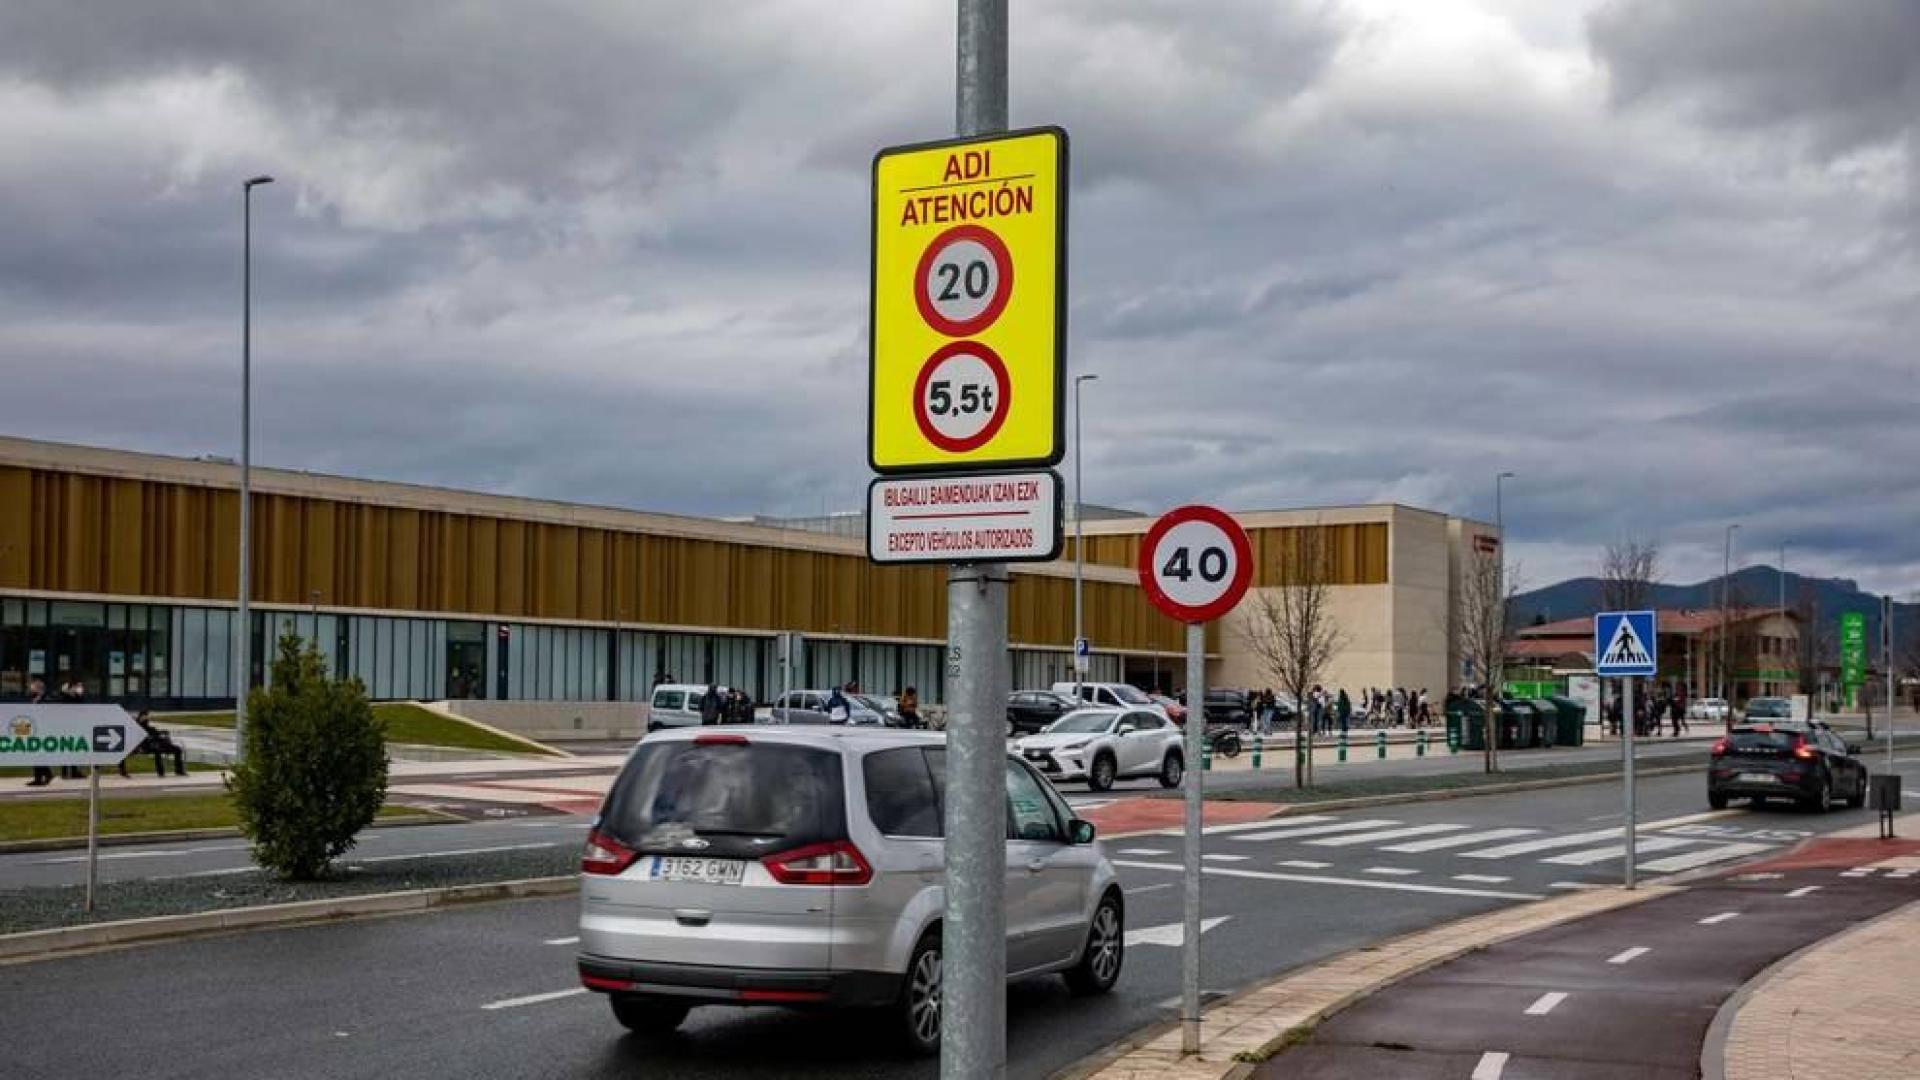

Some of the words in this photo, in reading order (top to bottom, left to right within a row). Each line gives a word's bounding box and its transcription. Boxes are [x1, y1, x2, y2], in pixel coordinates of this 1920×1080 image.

[943, 149, 991, 182] ADI
[900, 181, 1034, 226] ATENCIÓN
[937, 259, 991, 301] 20
[929, 379, 994, 417] 5,5t
[884, 486, 927, 507] IBILGAILU
[930, 484, 992, 505] BAIMENDUAK
[993, 482, 1015, 502] IZAN
[1017, 480, 1039, 501] EZIK
[888, 531, 926, 552] EXCEPTO
[926, 527, 973, 551] VEHÍCULOS
[974, 528, 1033, 550] AUTORIZADOS
[1162, 546, 1229, 582] 40
[0, 736, 90, 752] CADONA
